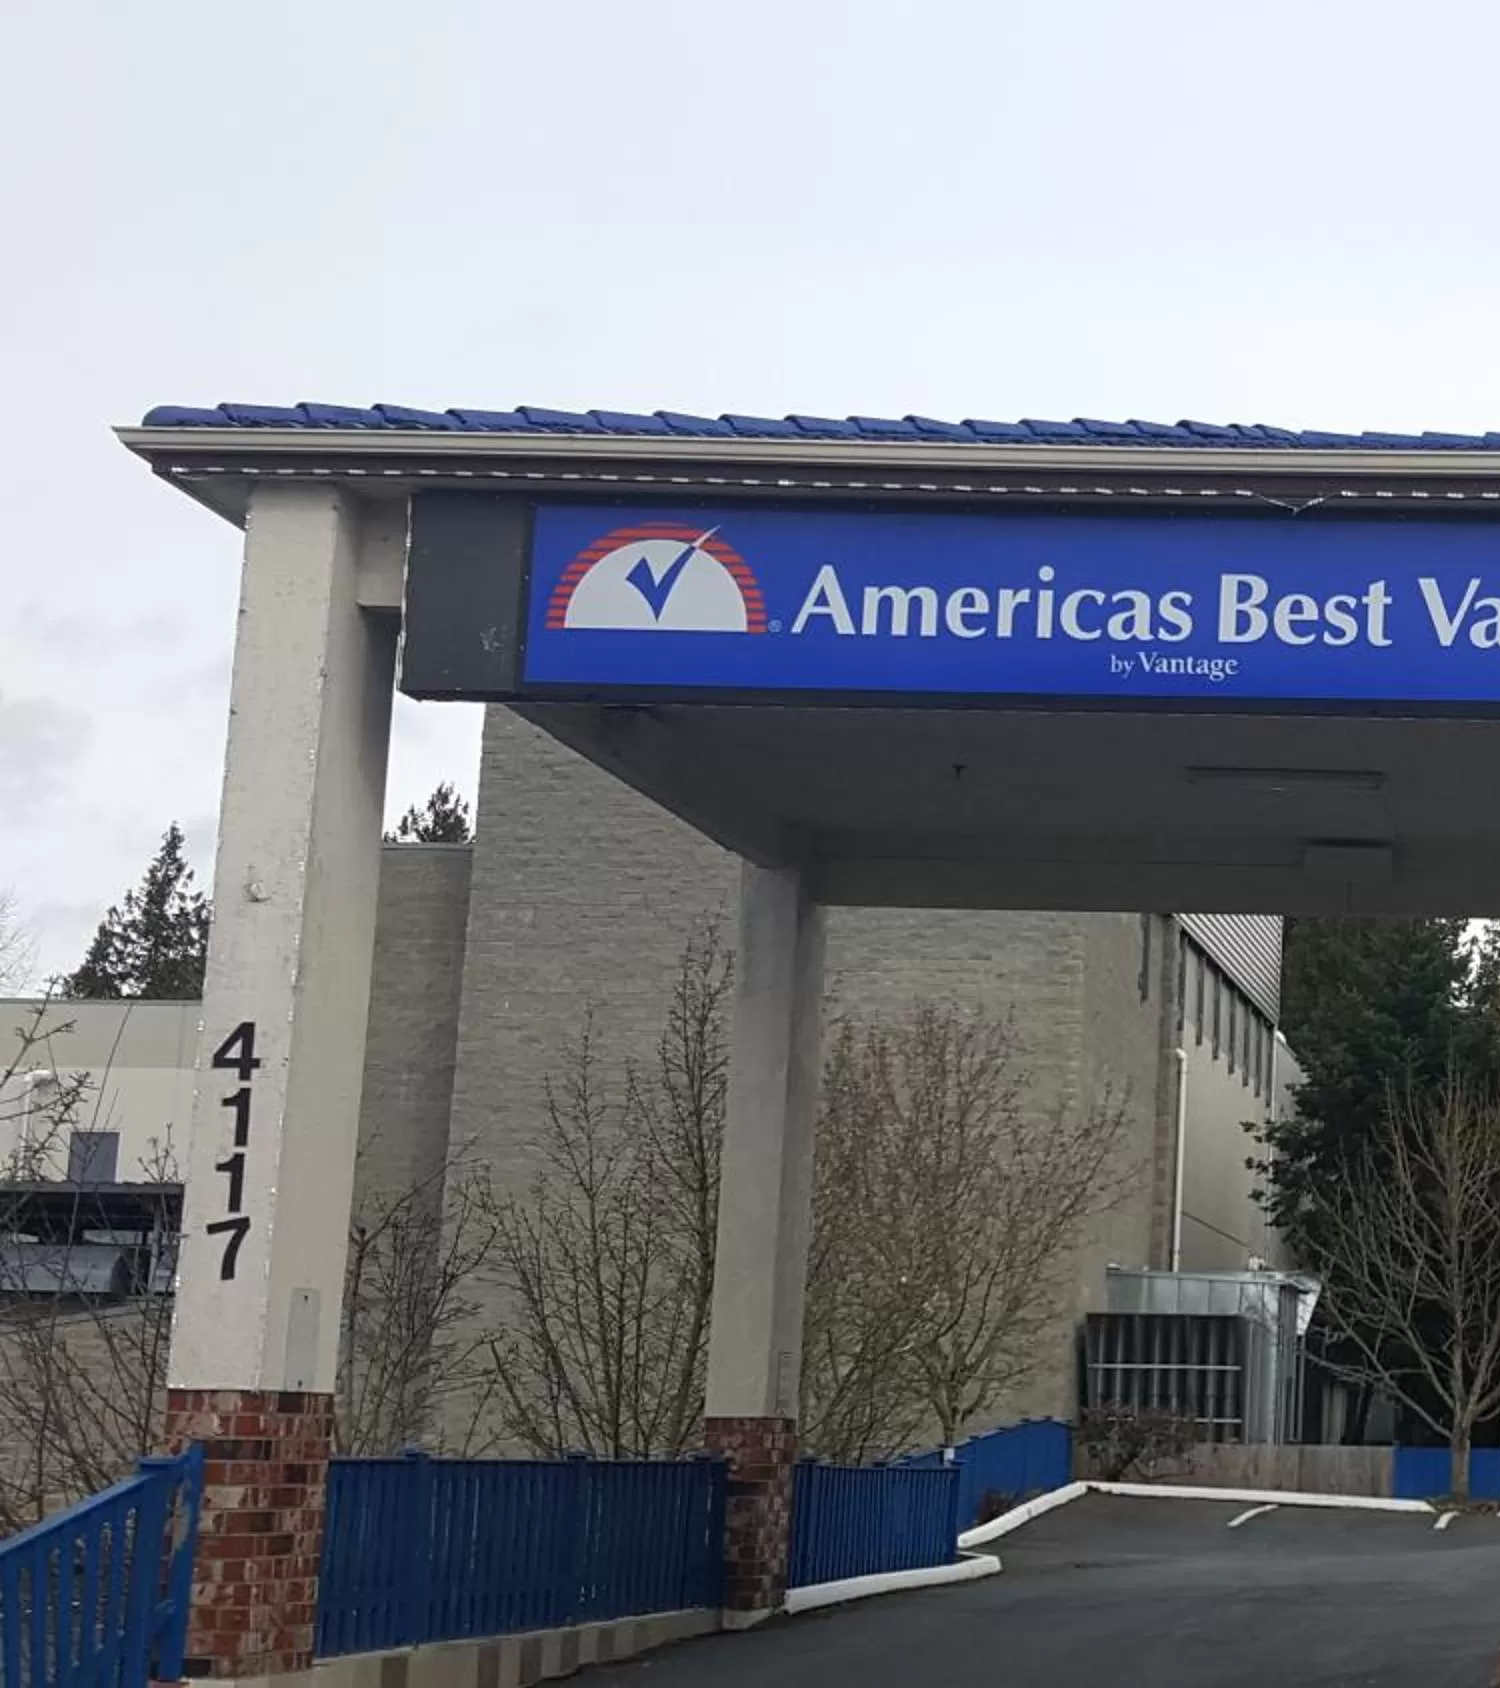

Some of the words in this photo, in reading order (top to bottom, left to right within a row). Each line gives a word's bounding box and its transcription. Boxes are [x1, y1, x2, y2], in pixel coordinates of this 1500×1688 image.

[791, 565, 1193, 642] Americas
[1218, 573, 1393, 647] Best
[1110, 653, 1135, 679] by
[1136, 651, 1239, 682] Vantage
[207, 1022, 261, 1281] 4117
